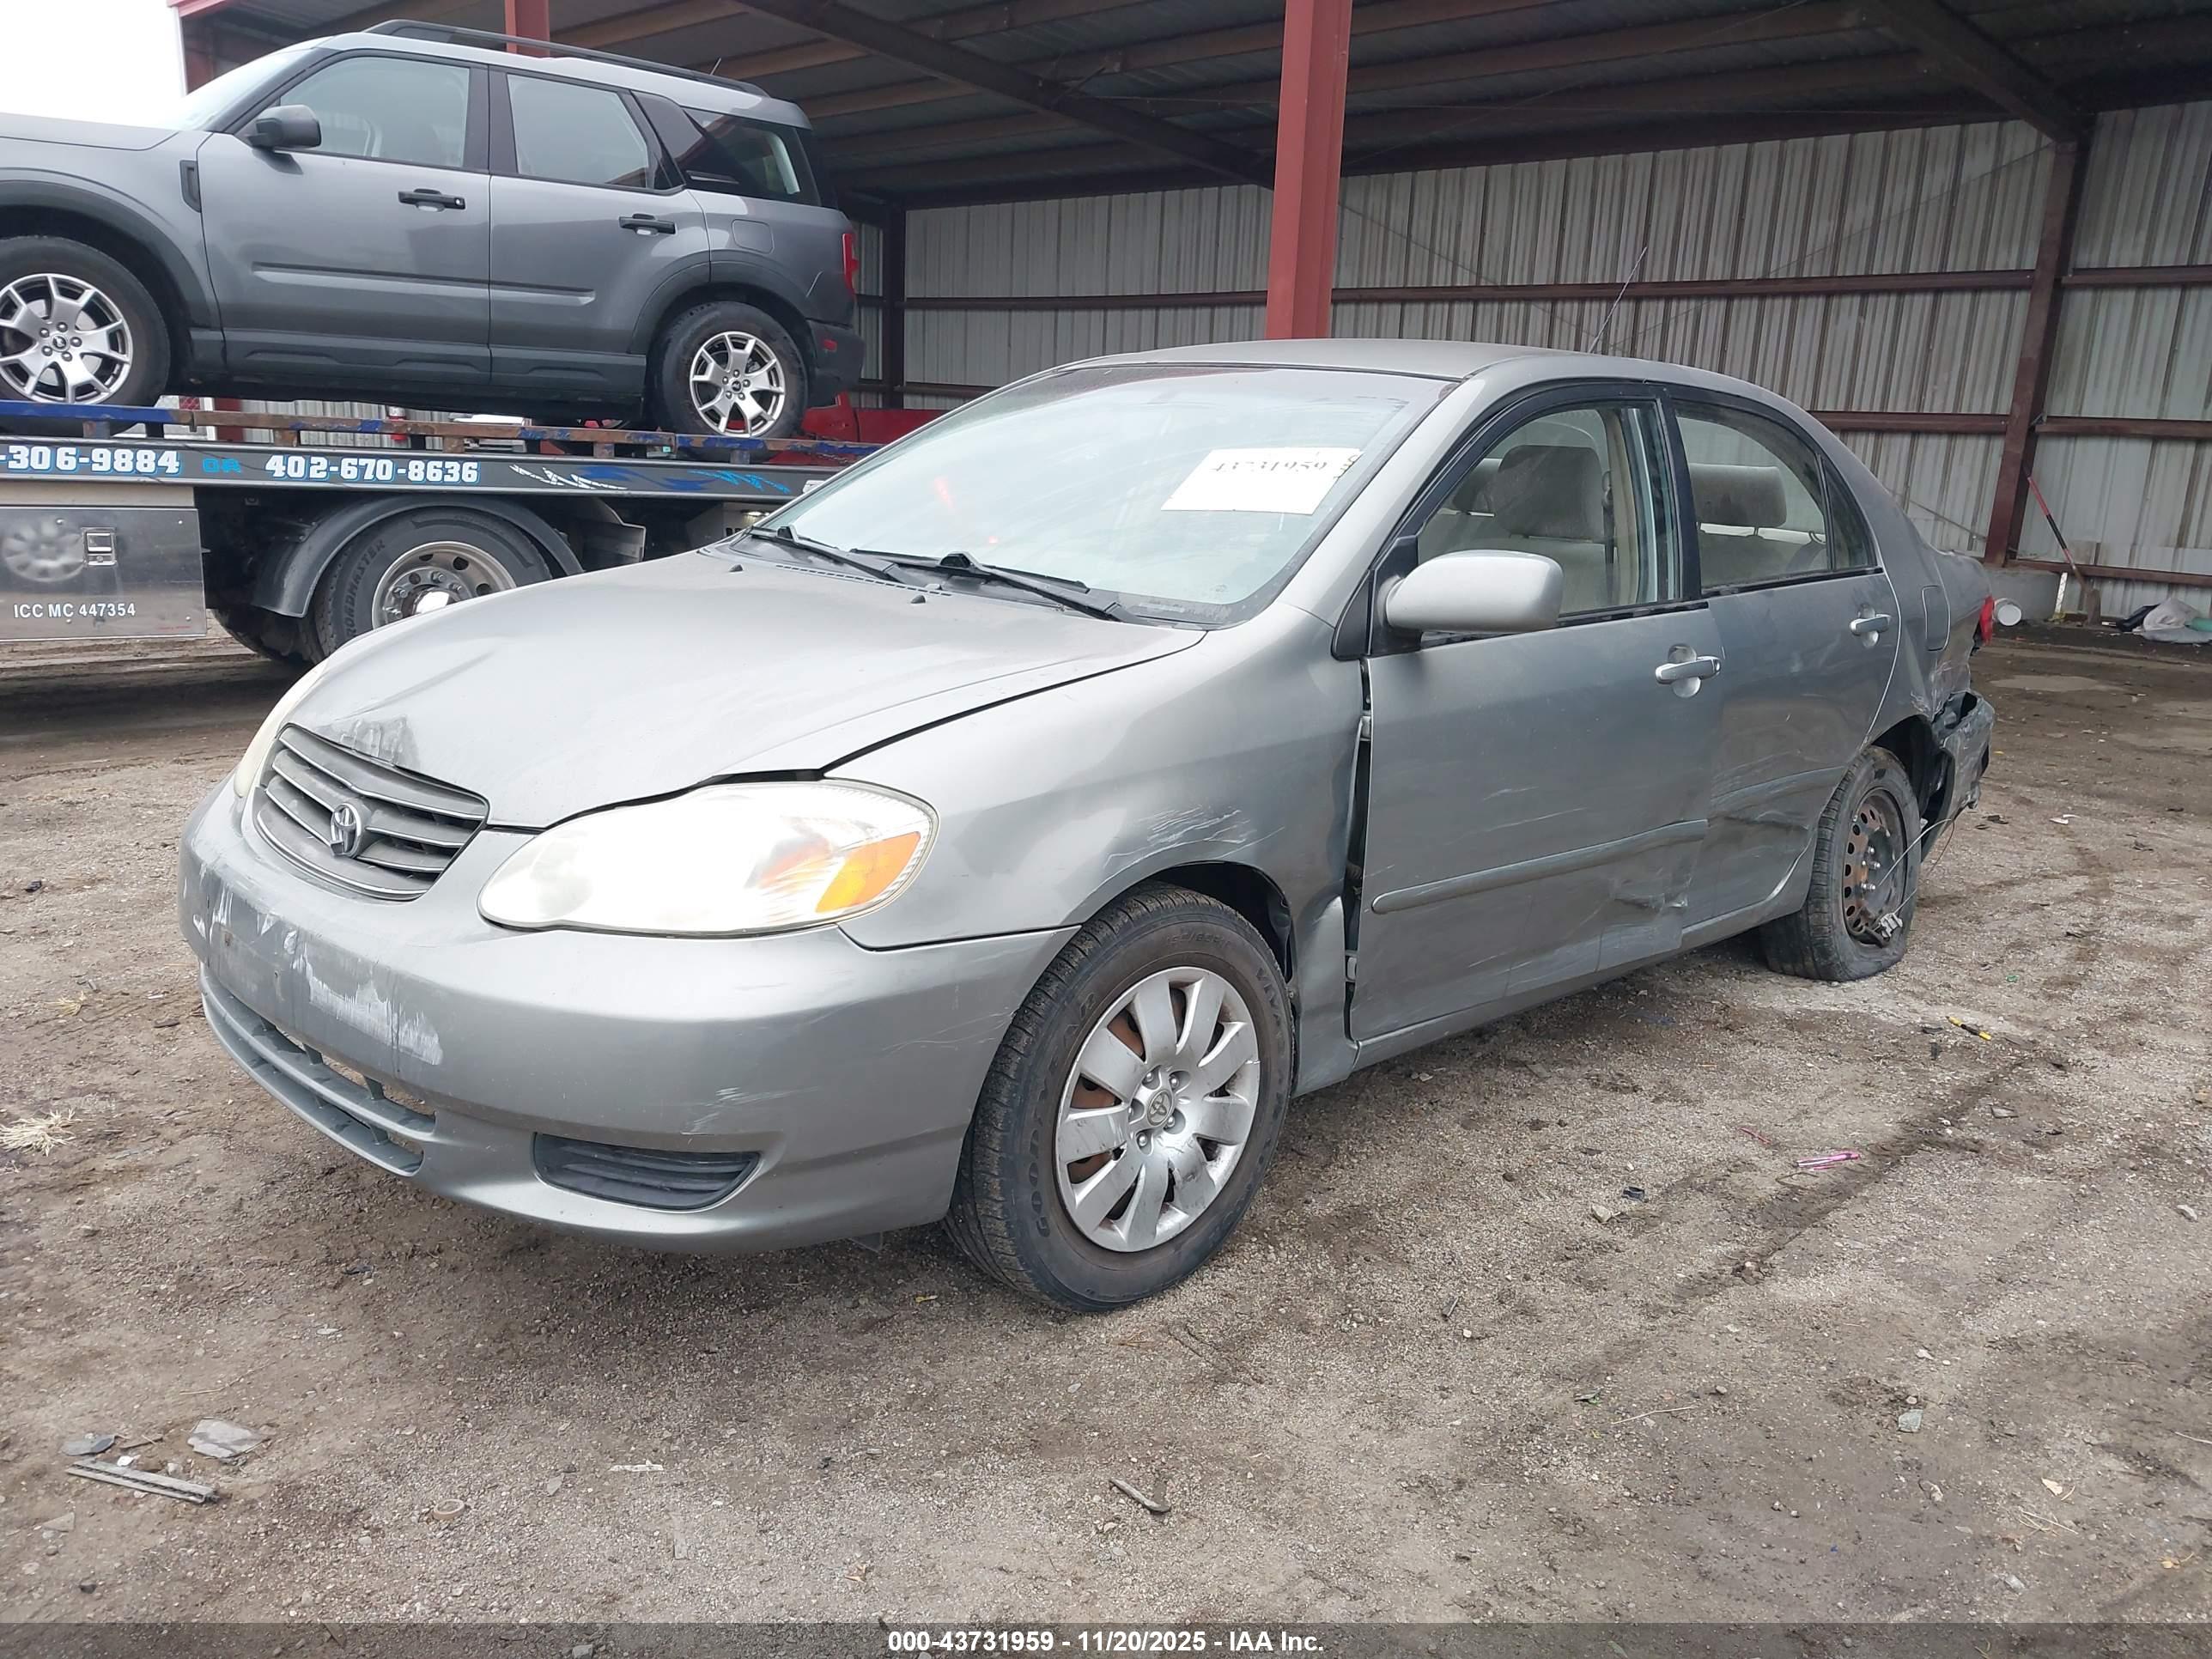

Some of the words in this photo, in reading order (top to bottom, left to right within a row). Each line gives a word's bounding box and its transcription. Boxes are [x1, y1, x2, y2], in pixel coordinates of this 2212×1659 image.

[203, 458, 241, 473] OR
[265, 454, 479, 483] 402-670-8636
[14, 604, 43, 618] ICC
[48, 604, 74, 617] MC
[79, 603, 136, 617] 447354
